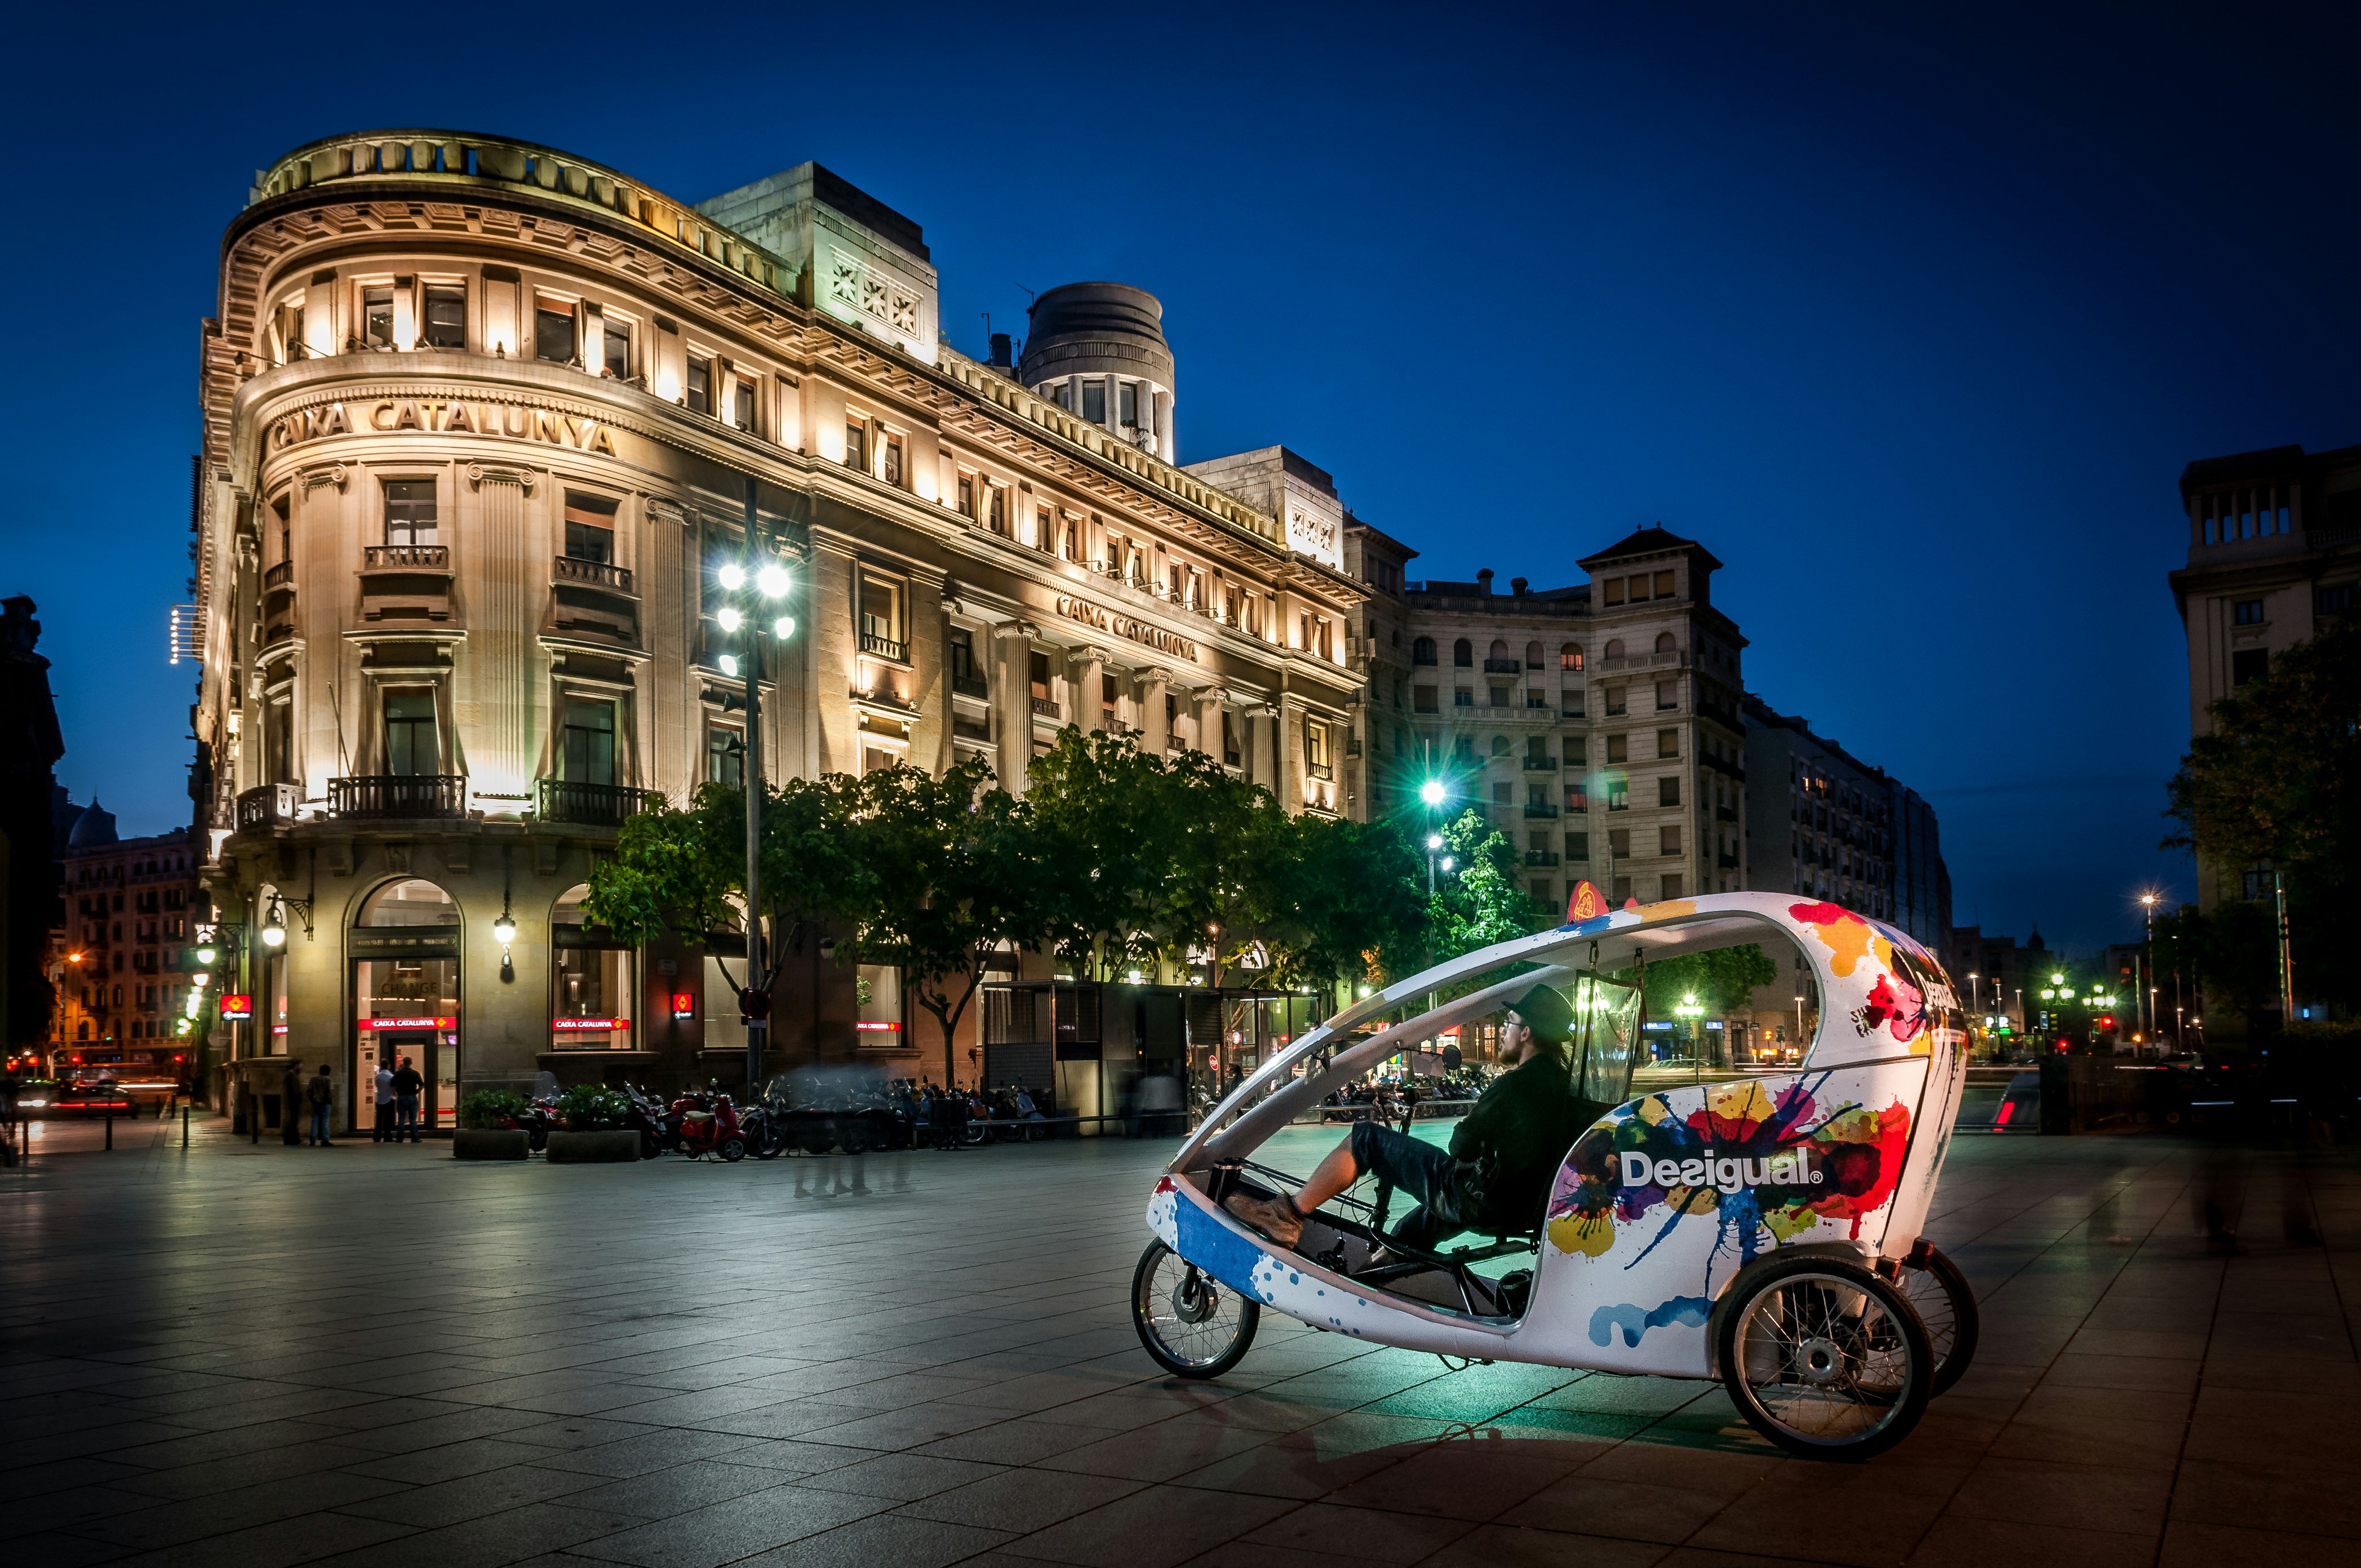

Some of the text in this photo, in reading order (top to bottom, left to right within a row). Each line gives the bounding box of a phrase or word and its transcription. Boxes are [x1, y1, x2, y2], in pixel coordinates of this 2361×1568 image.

[273, 399, 616, 456] CAIXA CATALUNYA
[1057, 595, 1199, 663] CAIXA CATALUNYA
[381, 982, 438, 994] CHANGE
